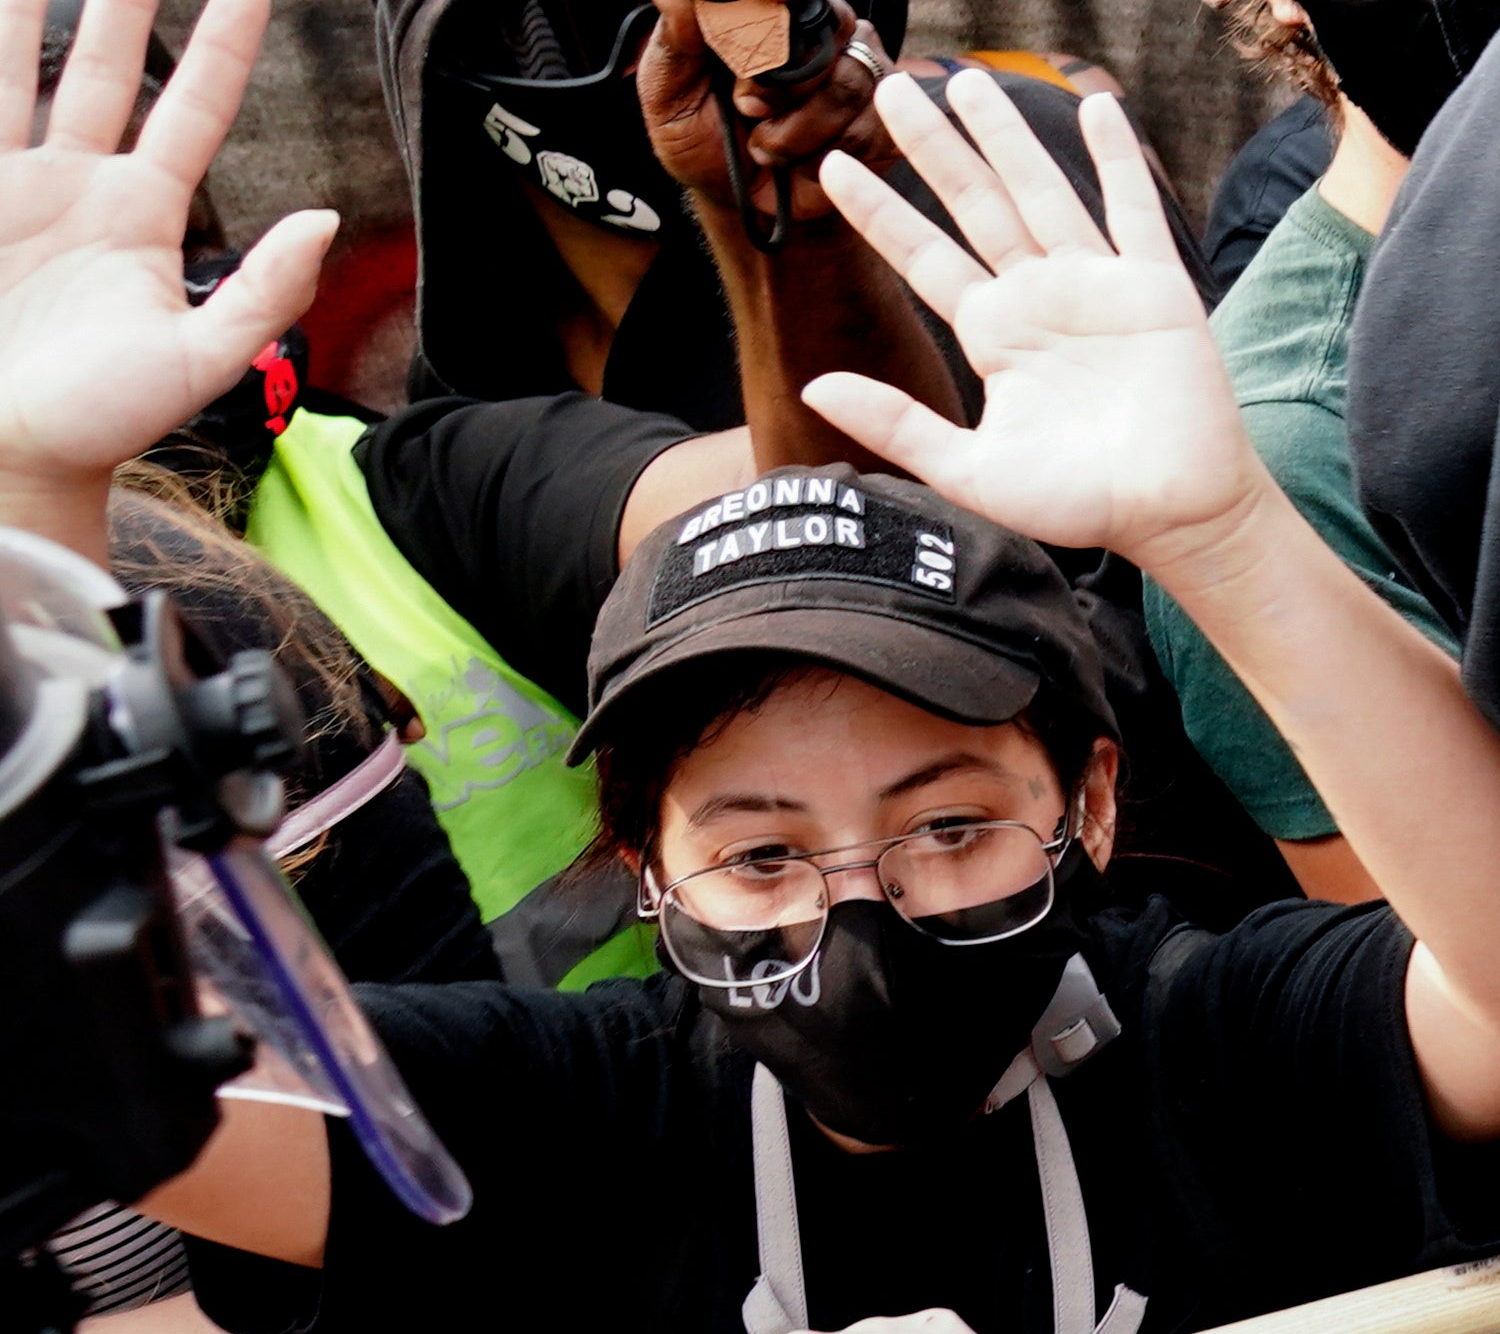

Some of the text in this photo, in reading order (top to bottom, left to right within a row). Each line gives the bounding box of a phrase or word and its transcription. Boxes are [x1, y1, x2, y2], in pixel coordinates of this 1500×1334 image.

[677, 478, 861, 545] BREONNA
[696, 516, 861, 574] TAYLOR
[916, 533, 955, 590] 502
